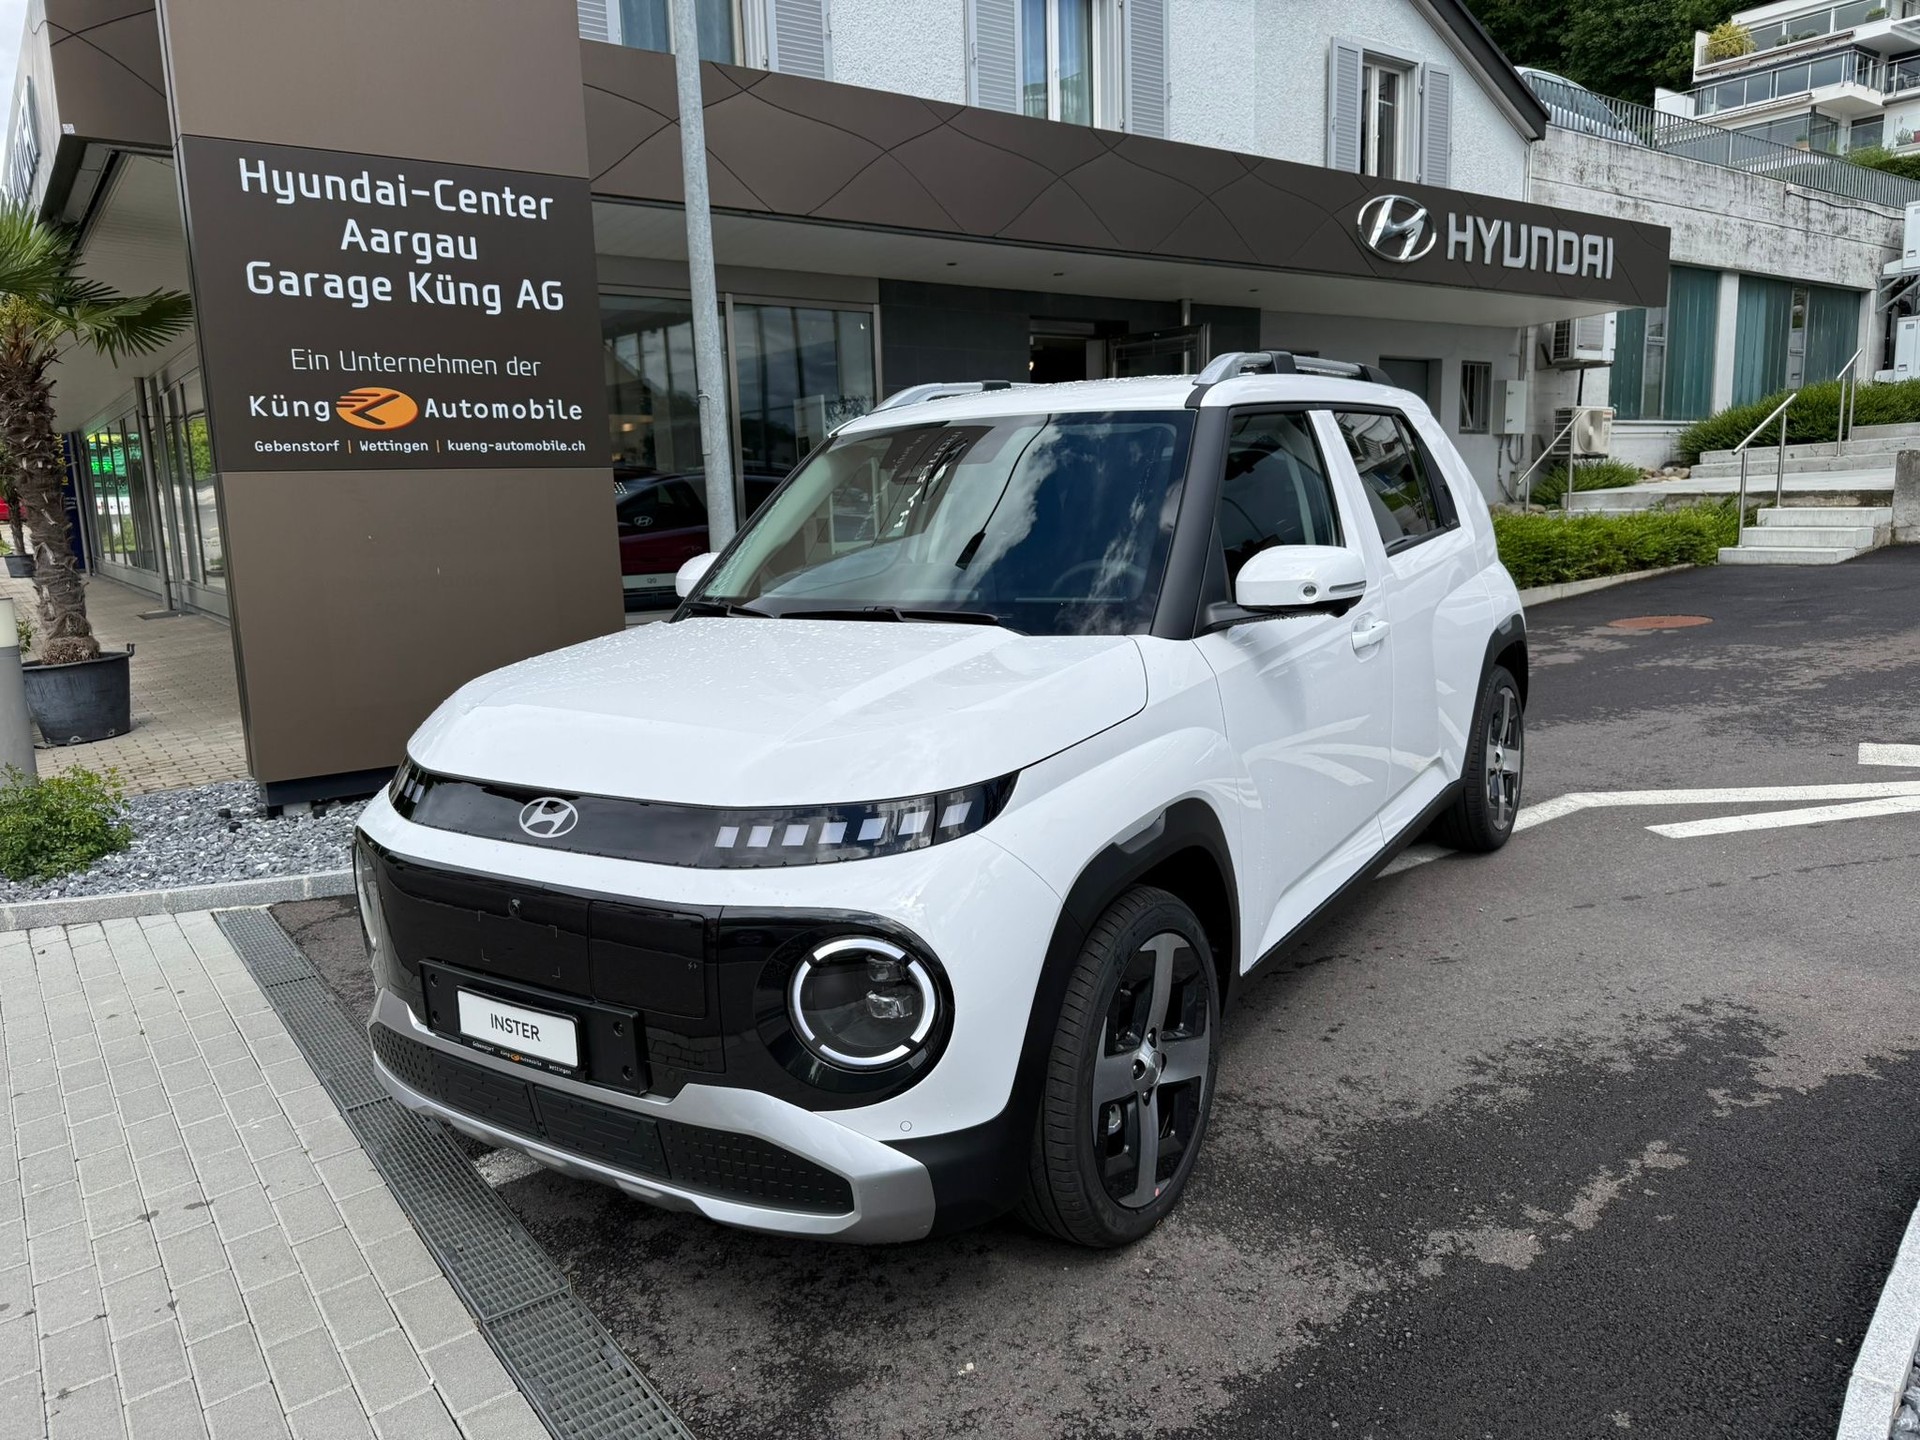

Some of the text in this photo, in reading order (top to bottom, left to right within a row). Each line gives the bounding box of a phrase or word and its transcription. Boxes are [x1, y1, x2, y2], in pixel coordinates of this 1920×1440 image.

[238, 156, 554, 223] Hyundai-Center
[340, 218, 478, 265] Aargau
[1446, 211, 1614, 280] HYUNDAI
[245, 260, 564, 316] Garage Küng AG
[290, 348, 541, 377] Ein Unternehmen der
[249, 394, 583, 422] Küng Automobile
[254, 439, 586, 455] Gebenstorf Wettingen kueng-automobile.ch
[490, 1013, 541, 1042] INSTER
